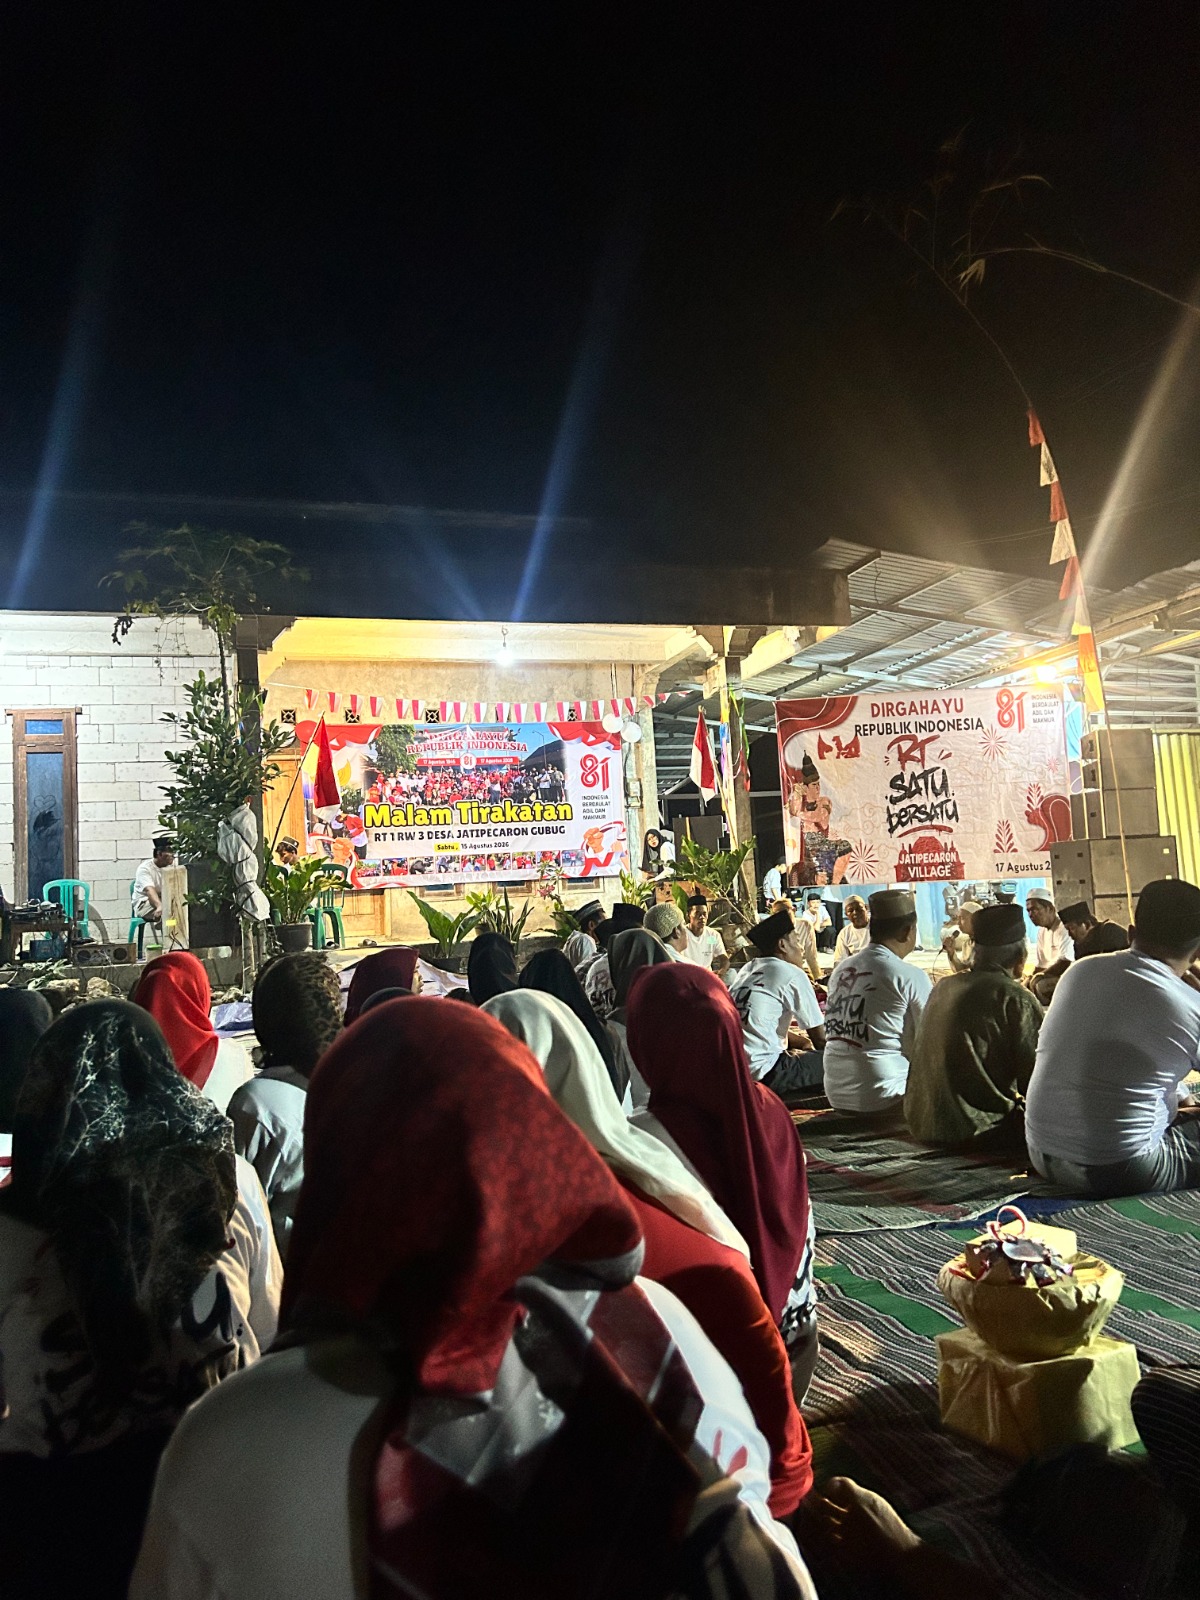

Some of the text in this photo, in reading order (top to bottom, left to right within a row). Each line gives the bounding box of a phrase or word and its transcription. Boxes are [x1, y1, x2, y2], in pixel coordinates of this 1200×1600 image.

[870, 698, 964, 718] DIRGAHAYU
[996, 688, 1028, 734] 81
[854, 718, 985, 736] REPUBLIK INDONESIA
[407, 741, 528, 754] REPUBLIK INDONESIA
[887, 734, 940, 772] RT
[580, 754, 611, 792] 81
[889, 766, 950, 805] SATU
[364, 800, 573, 828] Malam Tirakatan
[374, 825, 565, 841] RT 1 RW 3 DESA JATIPECARON GUBUG
[899, 851, 957, 865] JATIPECARON
[995, 863, 1005, 872] 17
[1007, 862, 1044, 874] Agustus
[908, 866, 951, 878] VILLAGE
[824, 1017, 869, 1042] ERSATU
